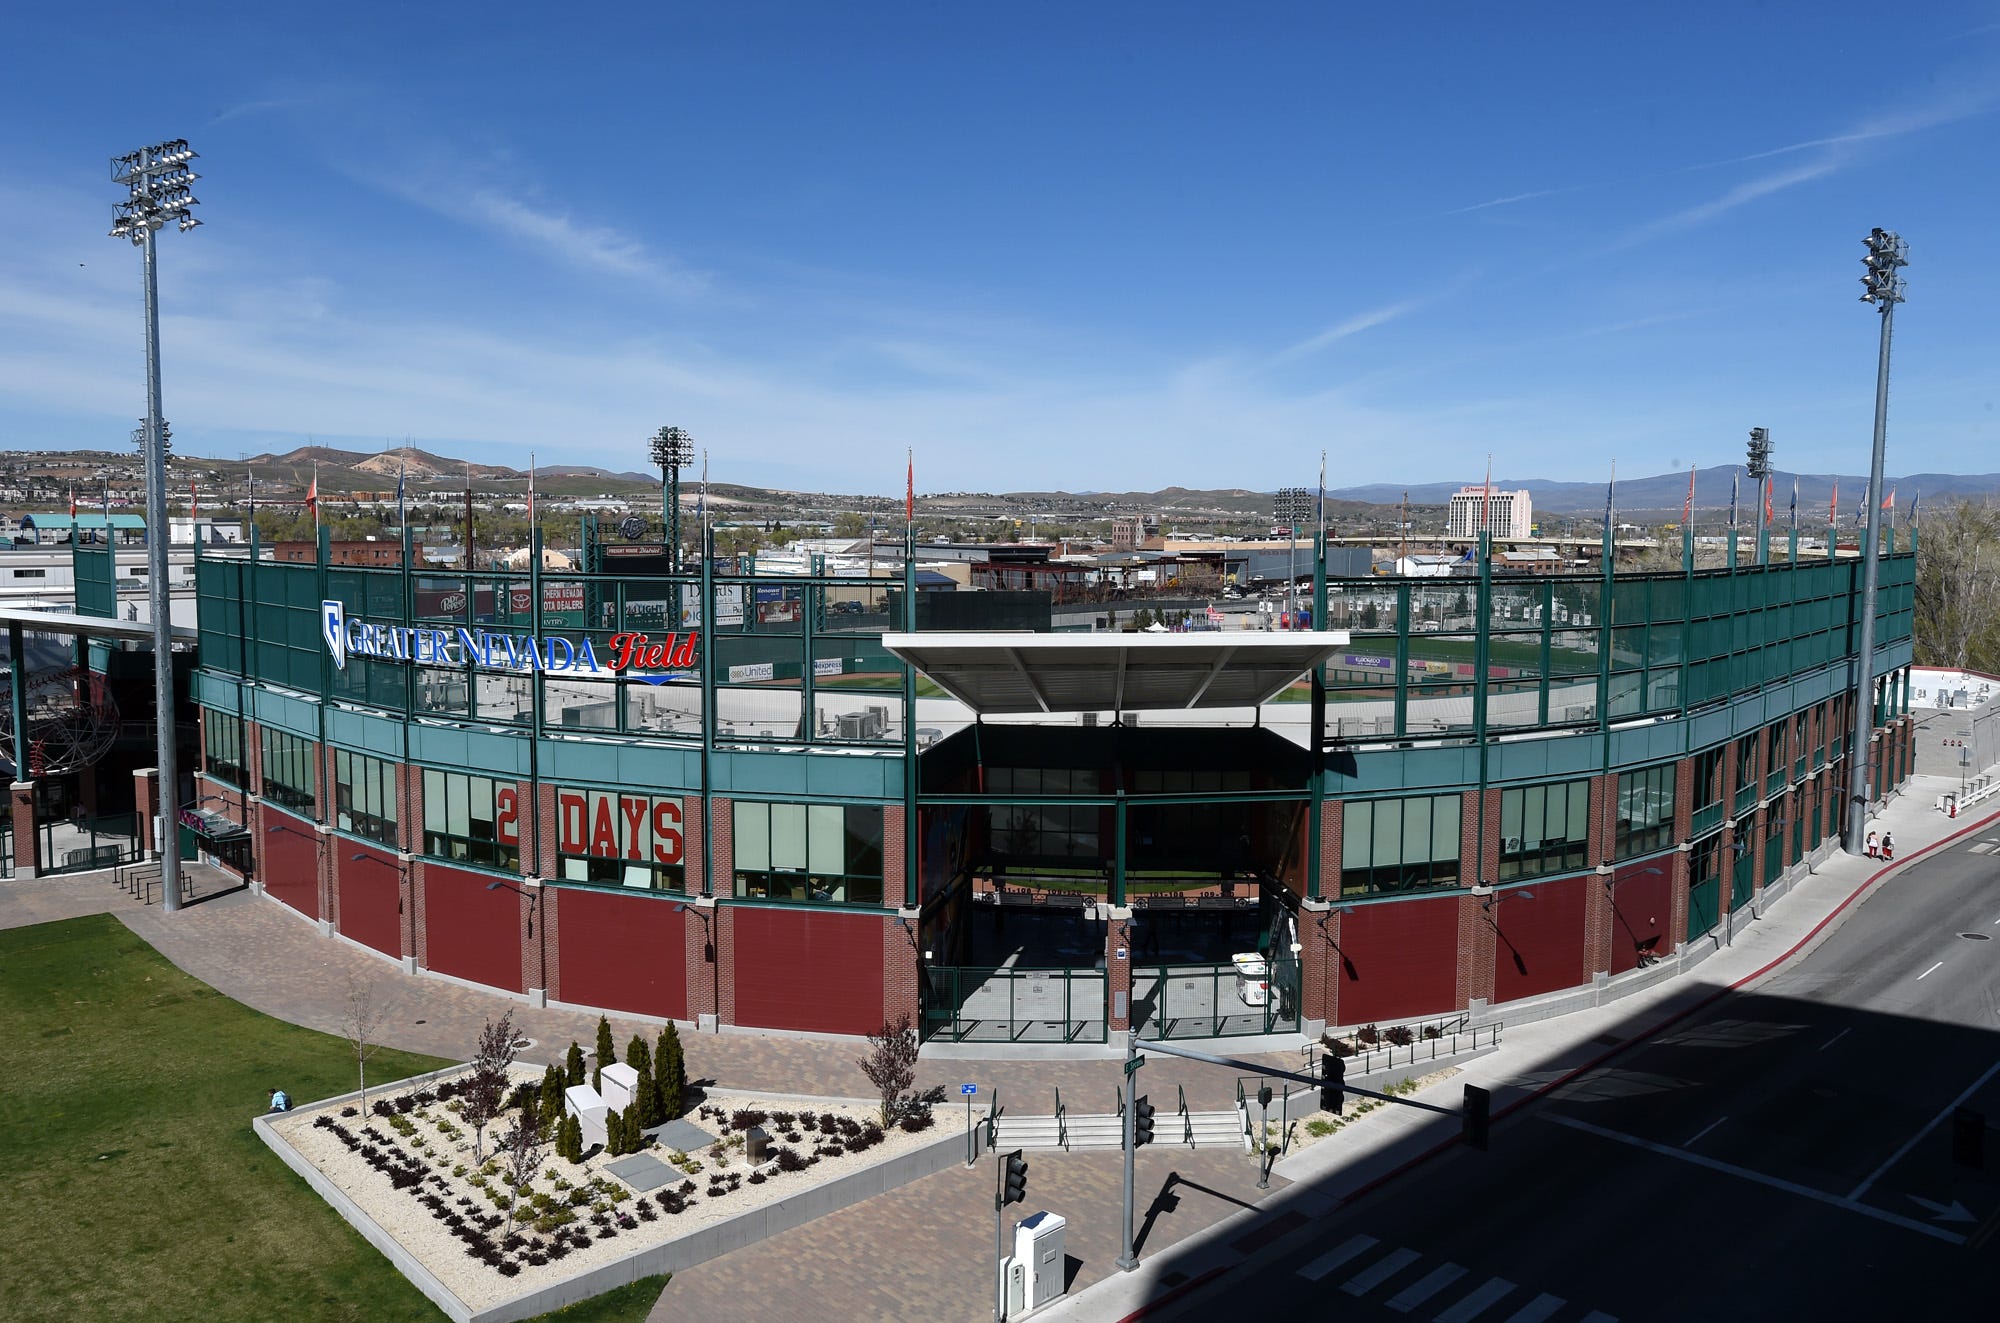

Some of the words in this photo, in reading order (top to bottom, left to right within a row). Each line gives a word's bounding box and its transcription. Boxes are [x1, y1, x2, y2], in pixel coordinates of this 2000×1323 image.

[543, 589, 561, 598] THERN
[562, 588, 583, 598] NEVADA
[543, 600, 556, 610] OTA
[557, 599, 584, 610] DEALERS
[345, 618, 450, 663] GREATER
[456, 628, 602, 673] NEVADA
[606, 631, 700, 671] Field
[745, 666, 772, 677] United
[498, 788, 518, 846] 2
[560, 793, 684, 865] DAYS
